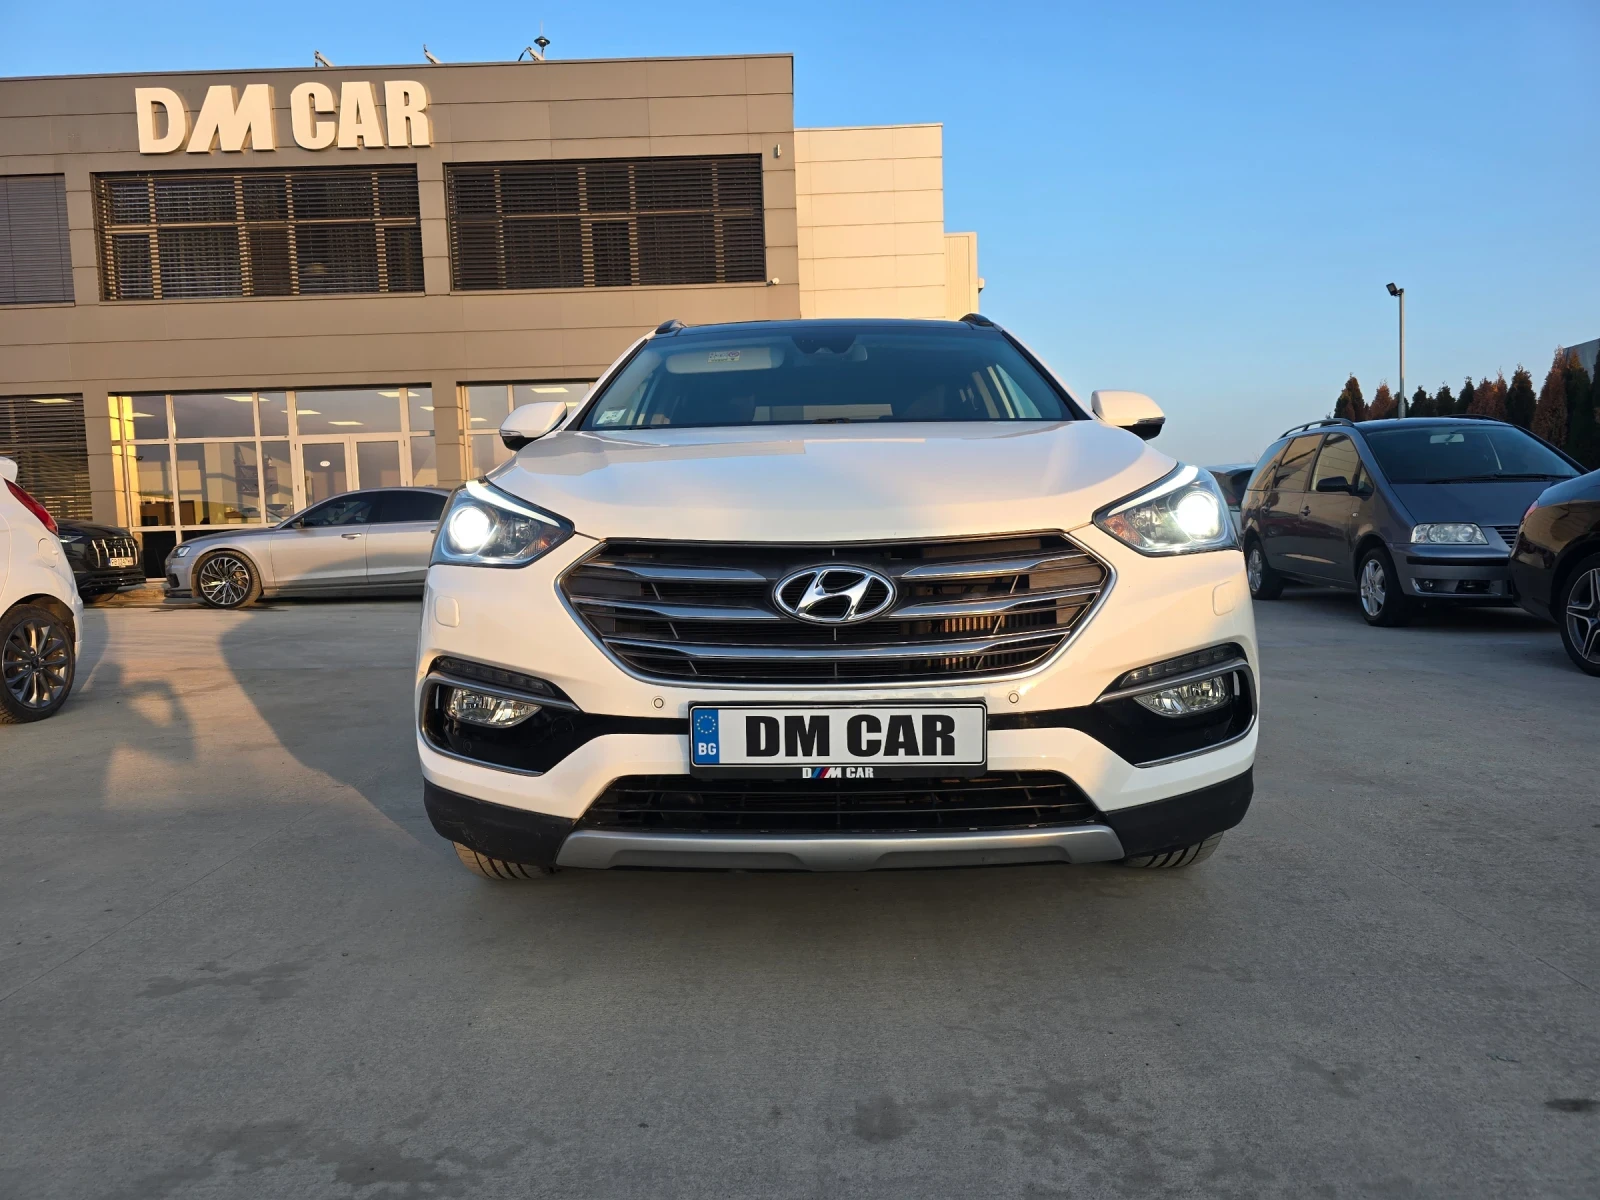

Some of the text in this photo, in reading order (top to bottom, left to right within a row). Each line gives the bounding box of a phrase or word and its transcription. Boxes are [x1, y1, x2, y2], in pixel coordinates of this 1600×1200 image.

[135, 80, 434, 154] DM CAR
[698, 742, 717, 755] BG
[745, 714, 956, 757] DM CAR
[846, 767, 874, 779] CAR
